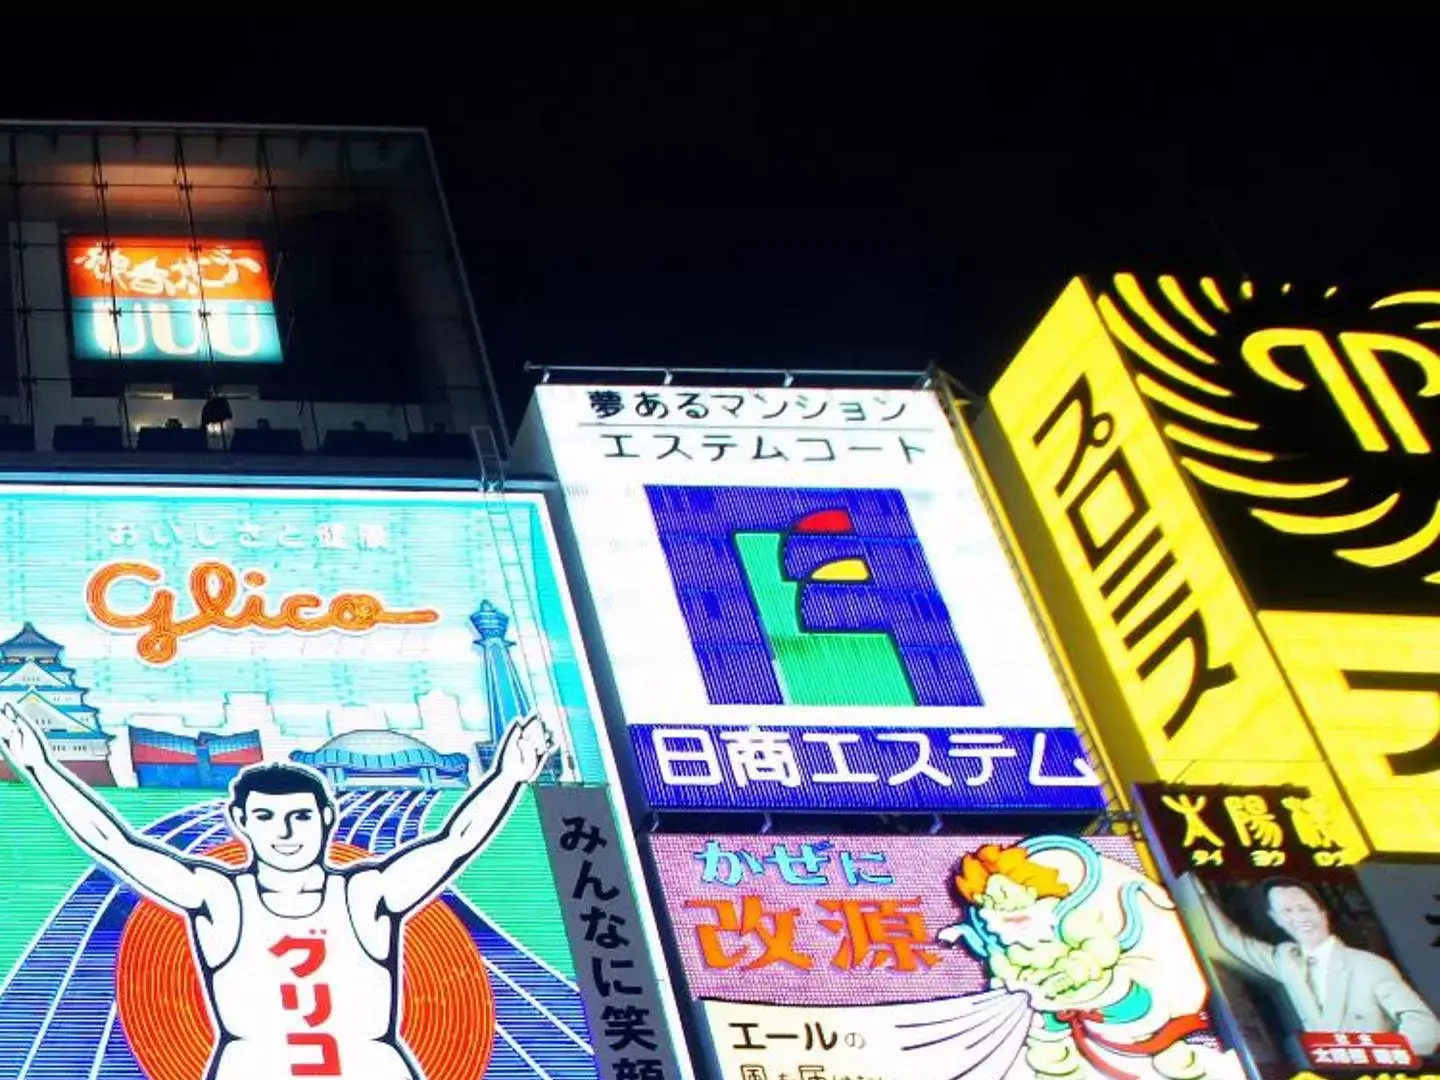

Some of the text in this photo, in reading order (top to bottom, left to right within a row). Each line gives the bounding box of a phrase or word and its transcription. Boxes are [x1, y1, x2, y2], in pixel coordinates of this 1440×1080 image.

[587, 390, 908, 421] 夢あるマンション
[604, 434, 928, 464] エステムコート
[1032, 372, 1239, 741] プロミス
[84, 558, 441, 664] Glico
[651, 725, 1106, 790] 日商エステム
[693, 839, 897, 887] かぜに
[685, 894, 946, 974] 改源
[268, 929, 343, 1078] グリコ
[728, 1022, 868, 1051] エールの
